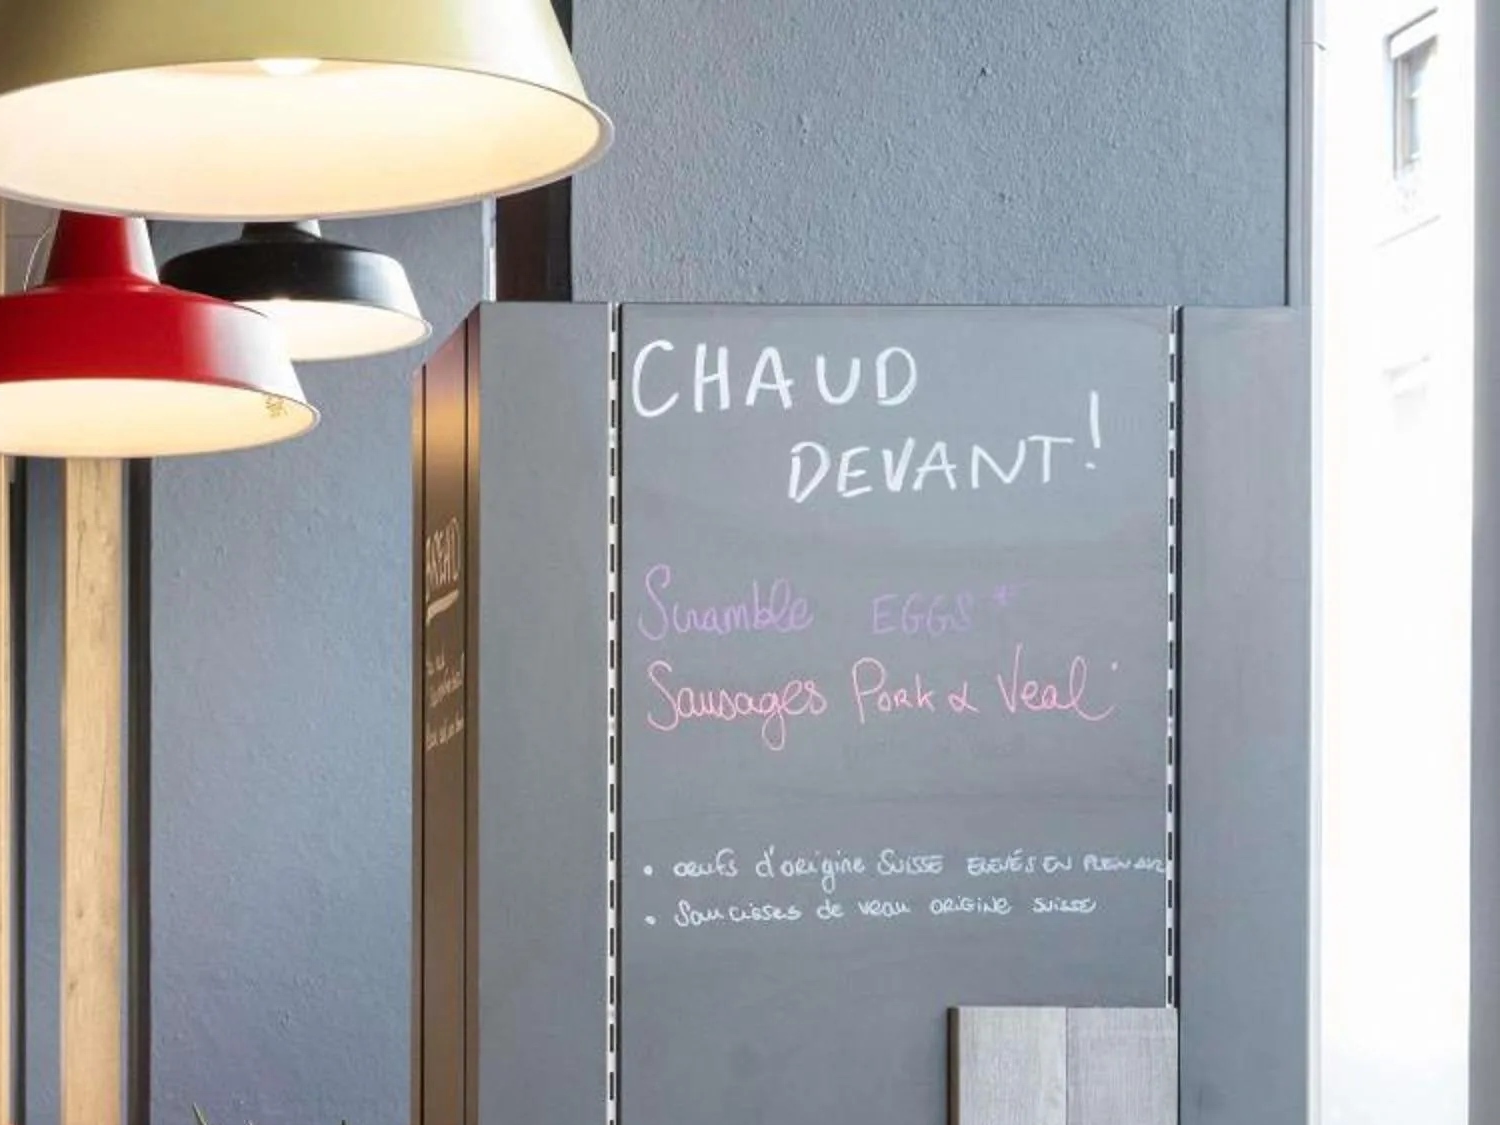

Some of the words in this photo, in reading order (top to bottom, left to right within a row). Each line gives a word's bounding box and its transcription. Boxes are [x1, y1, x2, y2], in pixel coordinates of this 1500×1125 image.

[631, 339, 918, 419] CHAUD
[646, 659, 828, 751] Sausages
[755, 845, 866, 894] d'origine
[673, 899, 803, 928] Saucisses
[816, 900, 845, 920] de
[857, 900, 911, 916] veau
